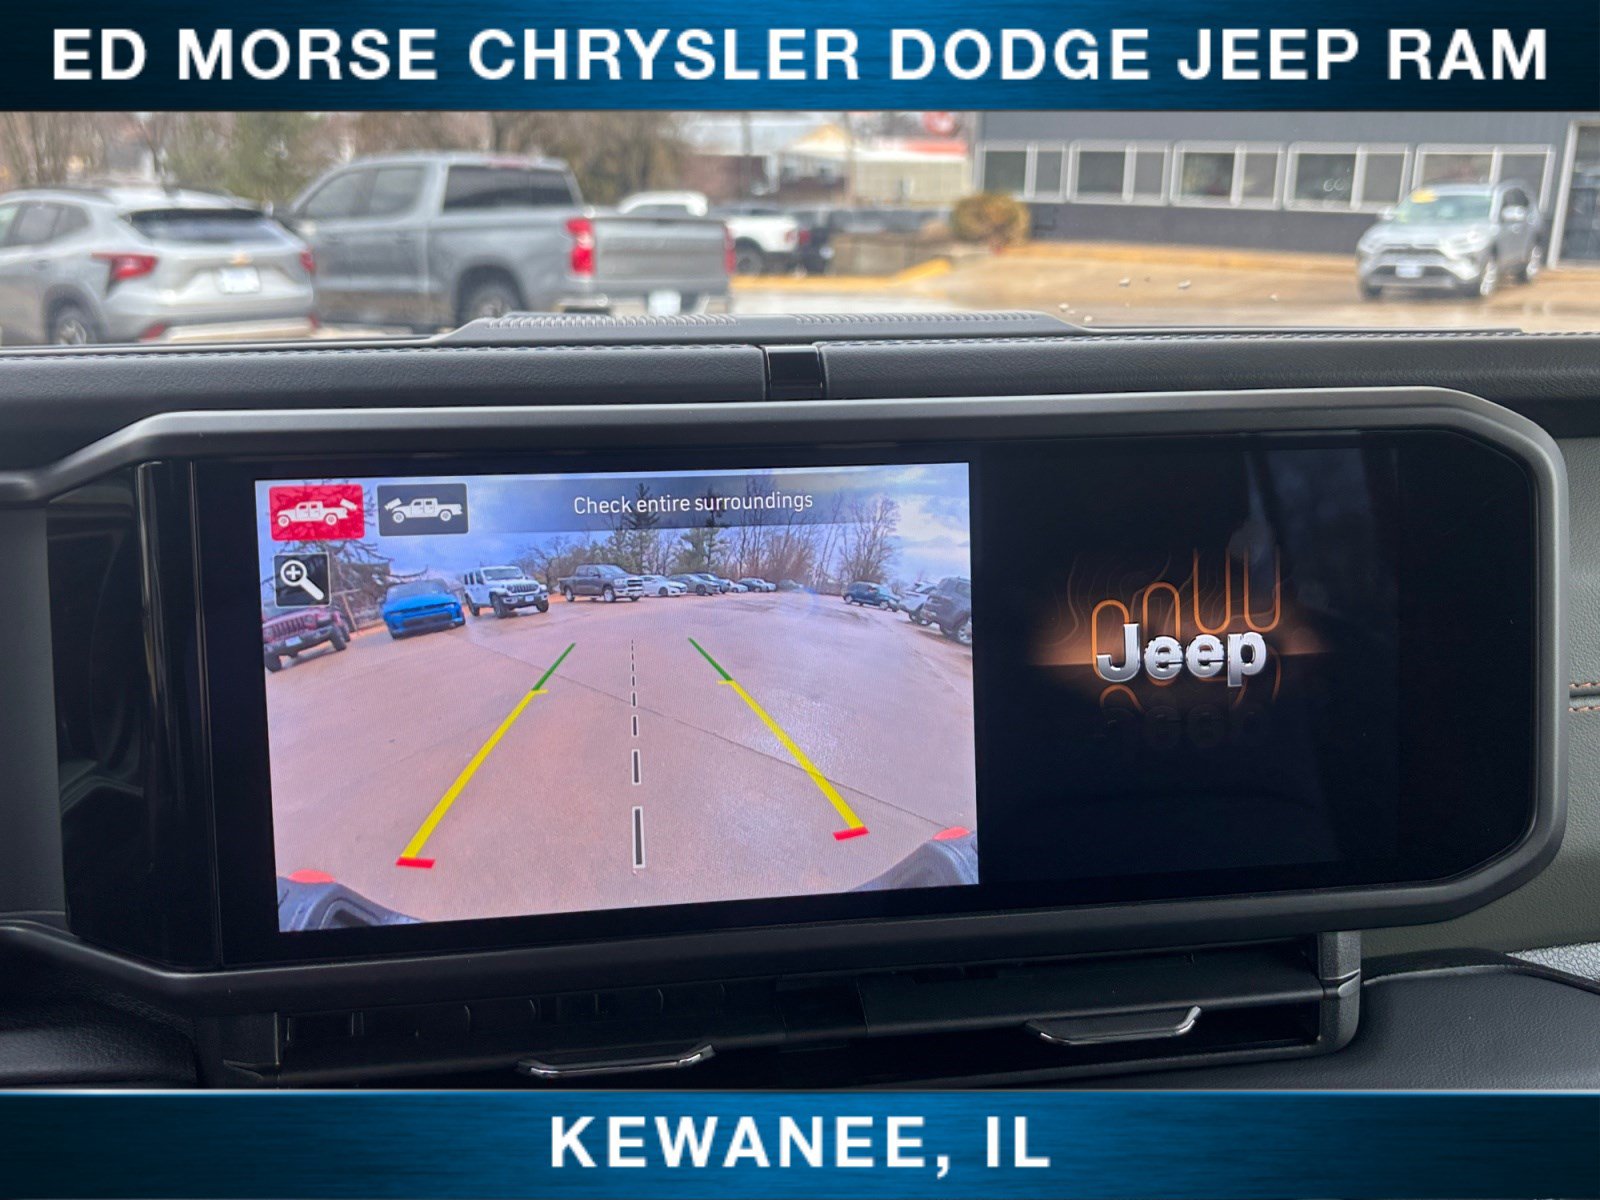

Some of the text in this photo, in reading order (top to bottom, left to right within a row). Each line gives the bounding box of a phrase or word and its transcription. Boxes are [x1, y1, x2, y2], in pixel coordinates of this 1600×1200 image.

[573, 491, 813, 515] Check entire surroundings
[1095, 622, 1267, 687] Jeep
